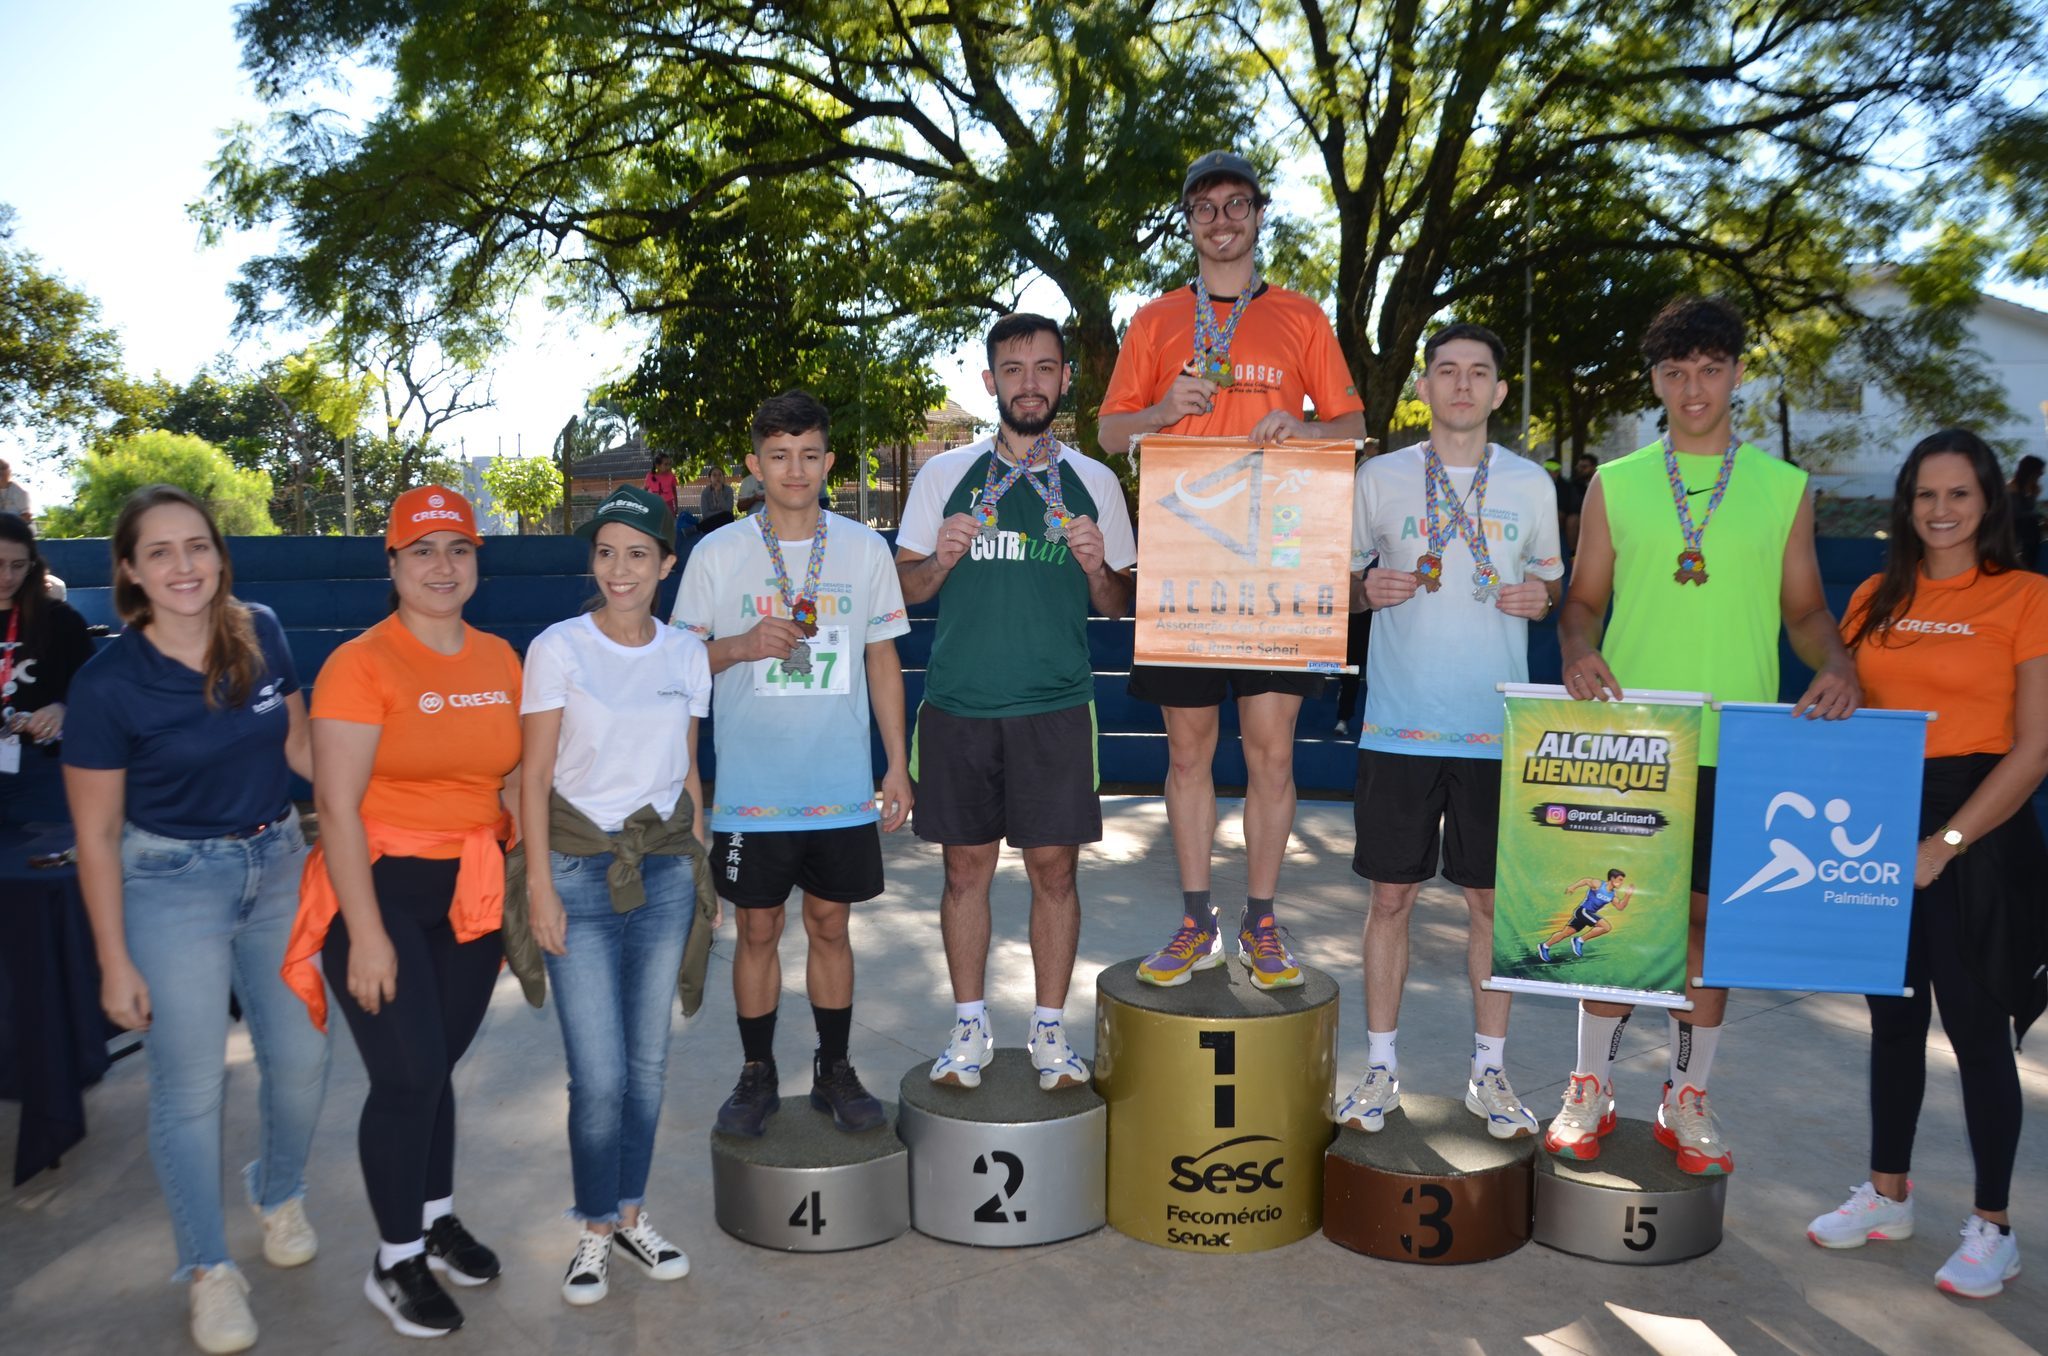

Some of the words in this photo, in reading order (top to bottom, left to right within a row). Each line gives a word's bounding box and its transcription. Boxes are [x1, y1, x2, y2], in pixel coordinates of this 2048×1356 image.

[412, 510, 464, 522] CRESOL
[1158, 579, 1335, 617] ACORSEB
[1155, 616, 1227, 635] Associação
[1258, 621, 1333, 636] Corredores
[1896, 618, 1976, 635] CRESOL
[1208, 640, 1234, 655] Rua
[1236, 641, 1253, 655] de
[1257, 642, 1300, 656] Seberi
[448, 691, 511, 707] CRESOL
[1537, 732, 1668, 764] ALCIMAR
[1526, 758, 1667, 791] HENRIQUE
[1567, 809, 1656, 825] @prof_alcimarh
[1818, 859, 1900, 884] GCOR
[1824, 890, 1899, 907] Palmitinho
[1199, 1031, 1236, 1129] 1
[973, 1150, 1027, 1223] 2
[789, 1191, 827, 1235] 4
[1166, 1204, 1283, 1225] Fecomércio
[1401, 1184, 1454, 1259] 3
[1167, 1227, 1231, 1248] Senac
[1623, 1206, 1658, 1252] 5
